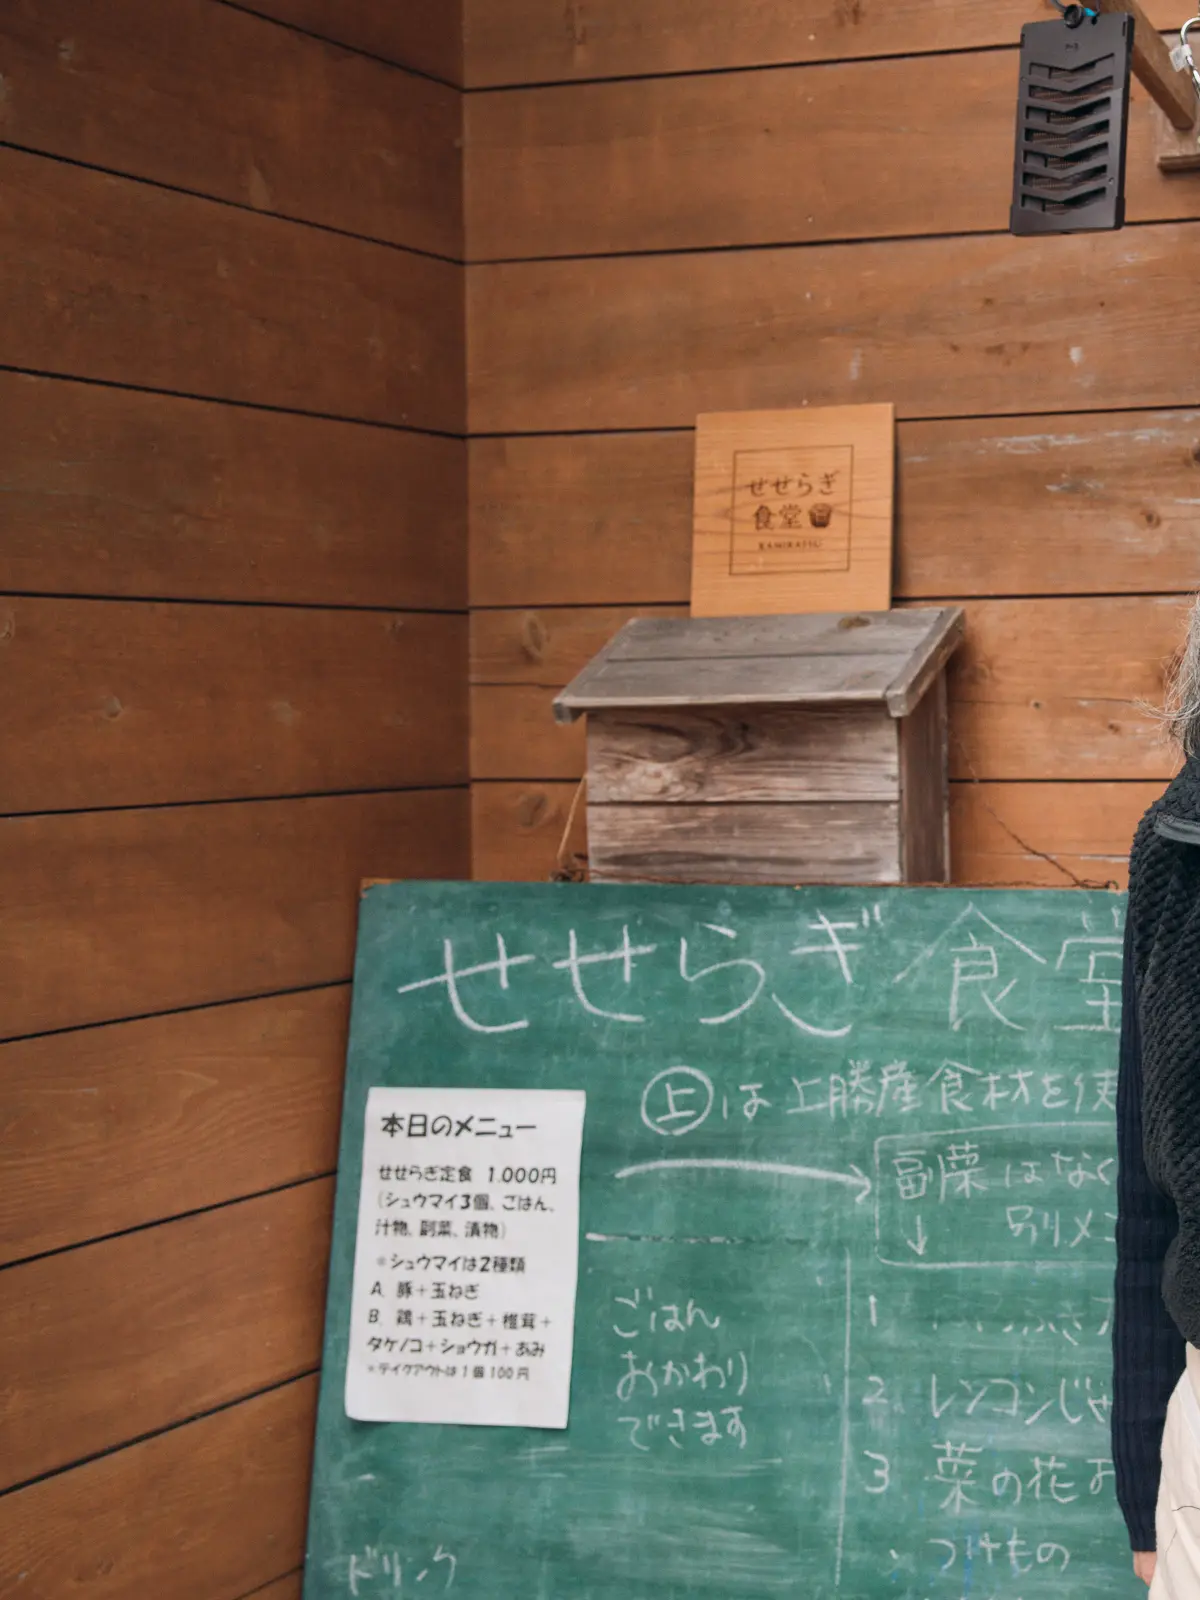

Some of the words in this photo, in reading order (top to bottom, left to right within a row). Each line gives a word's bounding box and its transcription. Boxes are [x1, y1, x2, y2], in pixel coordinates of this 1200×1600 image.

[750, 470, 840, 498] せせらぎ
[755, 503, 802, 531] 食堂
[381, 1114, 537, 1138] 本日のメニュー
[379, 1166, 472, 1183] せせらぎ定食
[612, 1287, 721, 1338] ごはん
[615, 1350, 748, 1402] おかわり
[617, 1406, 748, 1451] できます
